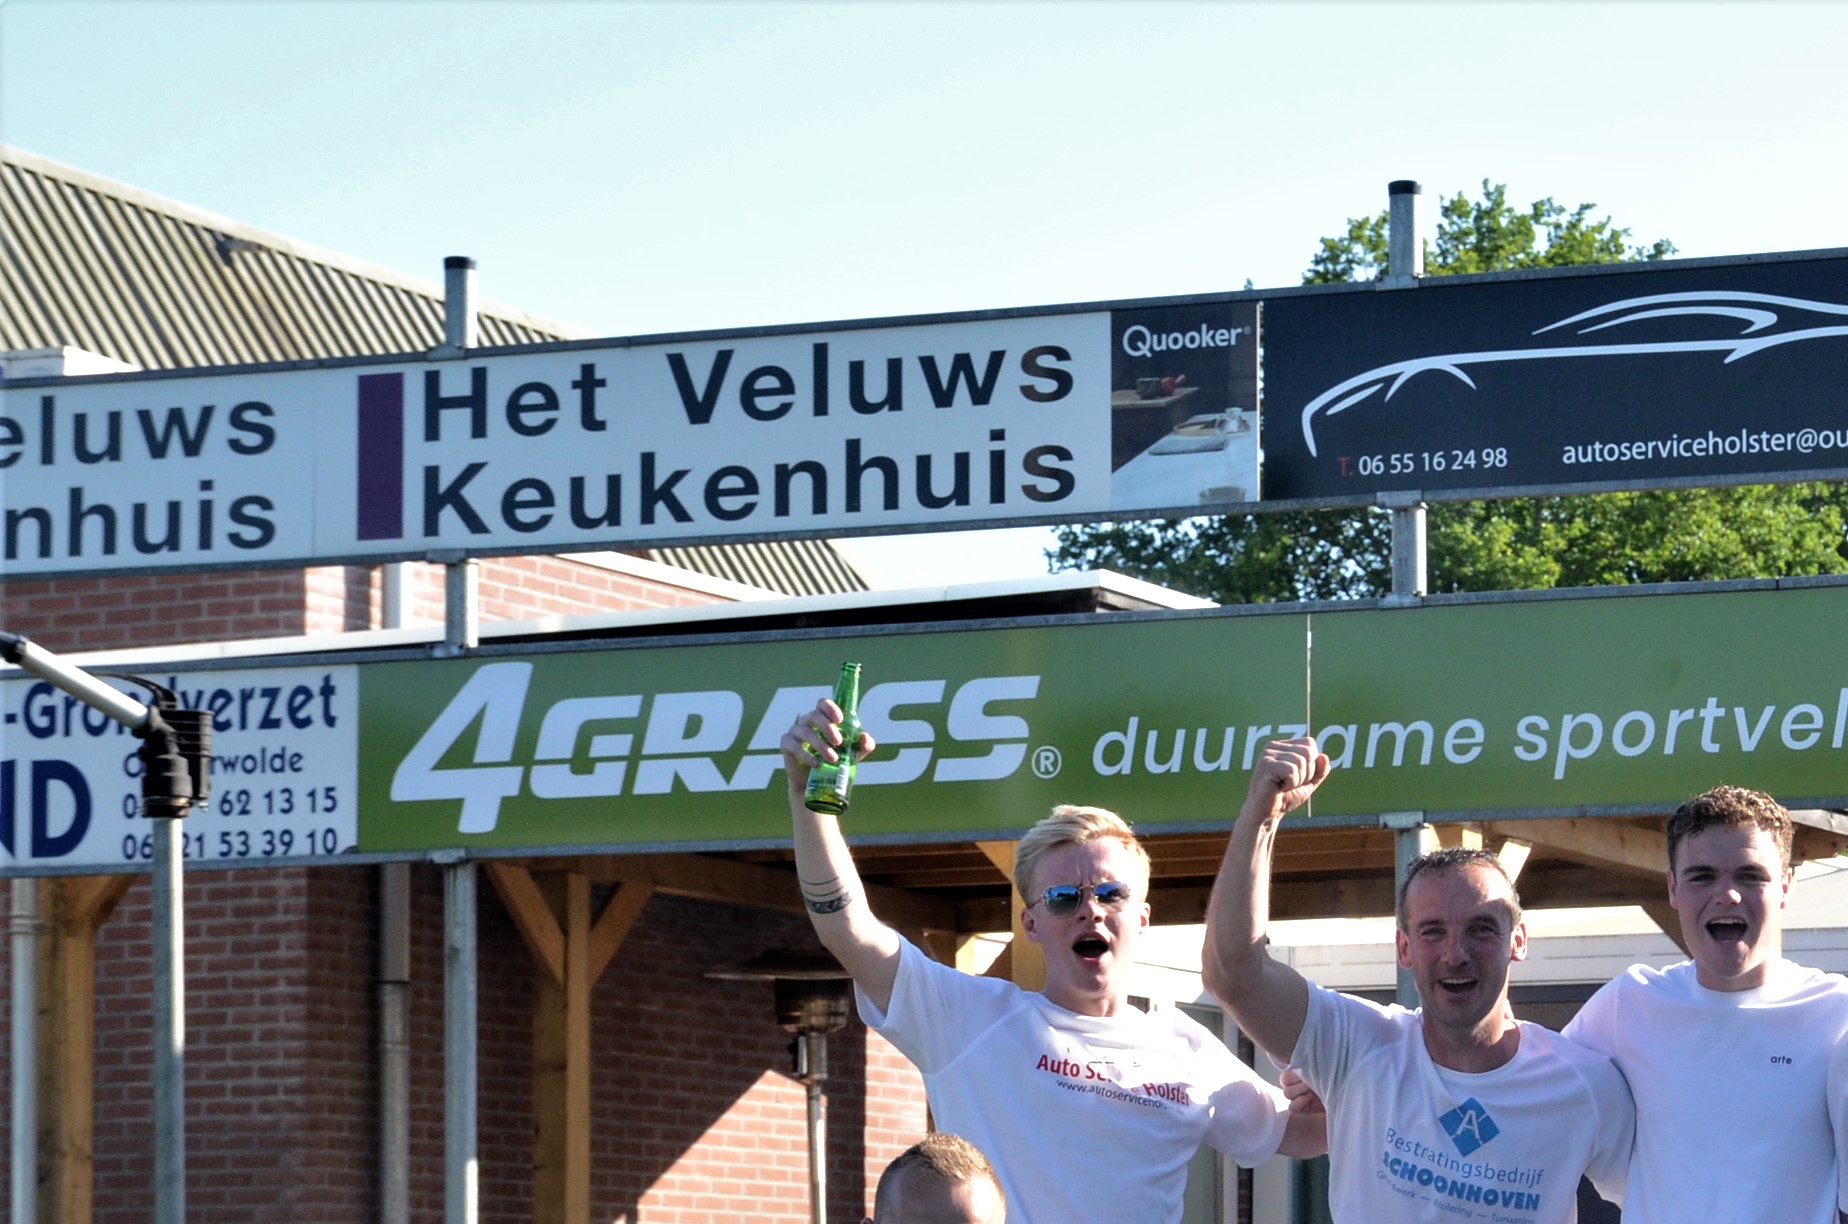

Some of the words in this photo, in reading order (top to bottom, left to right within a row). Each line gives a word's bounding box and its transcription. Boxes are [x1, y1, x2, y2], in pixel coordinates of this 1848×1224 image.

[1122, 323, 1242, 358] Quooker
[423, 363, 608, 442] Het
[667, 342, 1075, 425] Veluws
[1358, 455, 1384, 475] 06
[1389, 453, 1415, 474] 55
[1421, 451, 1445, 472] 16
[1452, 449, 1477, 471] 24
[1481, 447, 1508, 469] 98
[423, 429, 1077, 537] Keukenhuis
[219, 790, 251, 817] 62
[265, 788, 294, 814] 13
[306, 787, 337, 813] 15
[219, 831, 249, 857] 53
[263, 830, 293, 855] 39
[307, 828, 337, 854] 10
[1036, 1054, 1081, 1078] Auto
[1386, 1128, 1544, 1188] Bestratingsbedrijf
